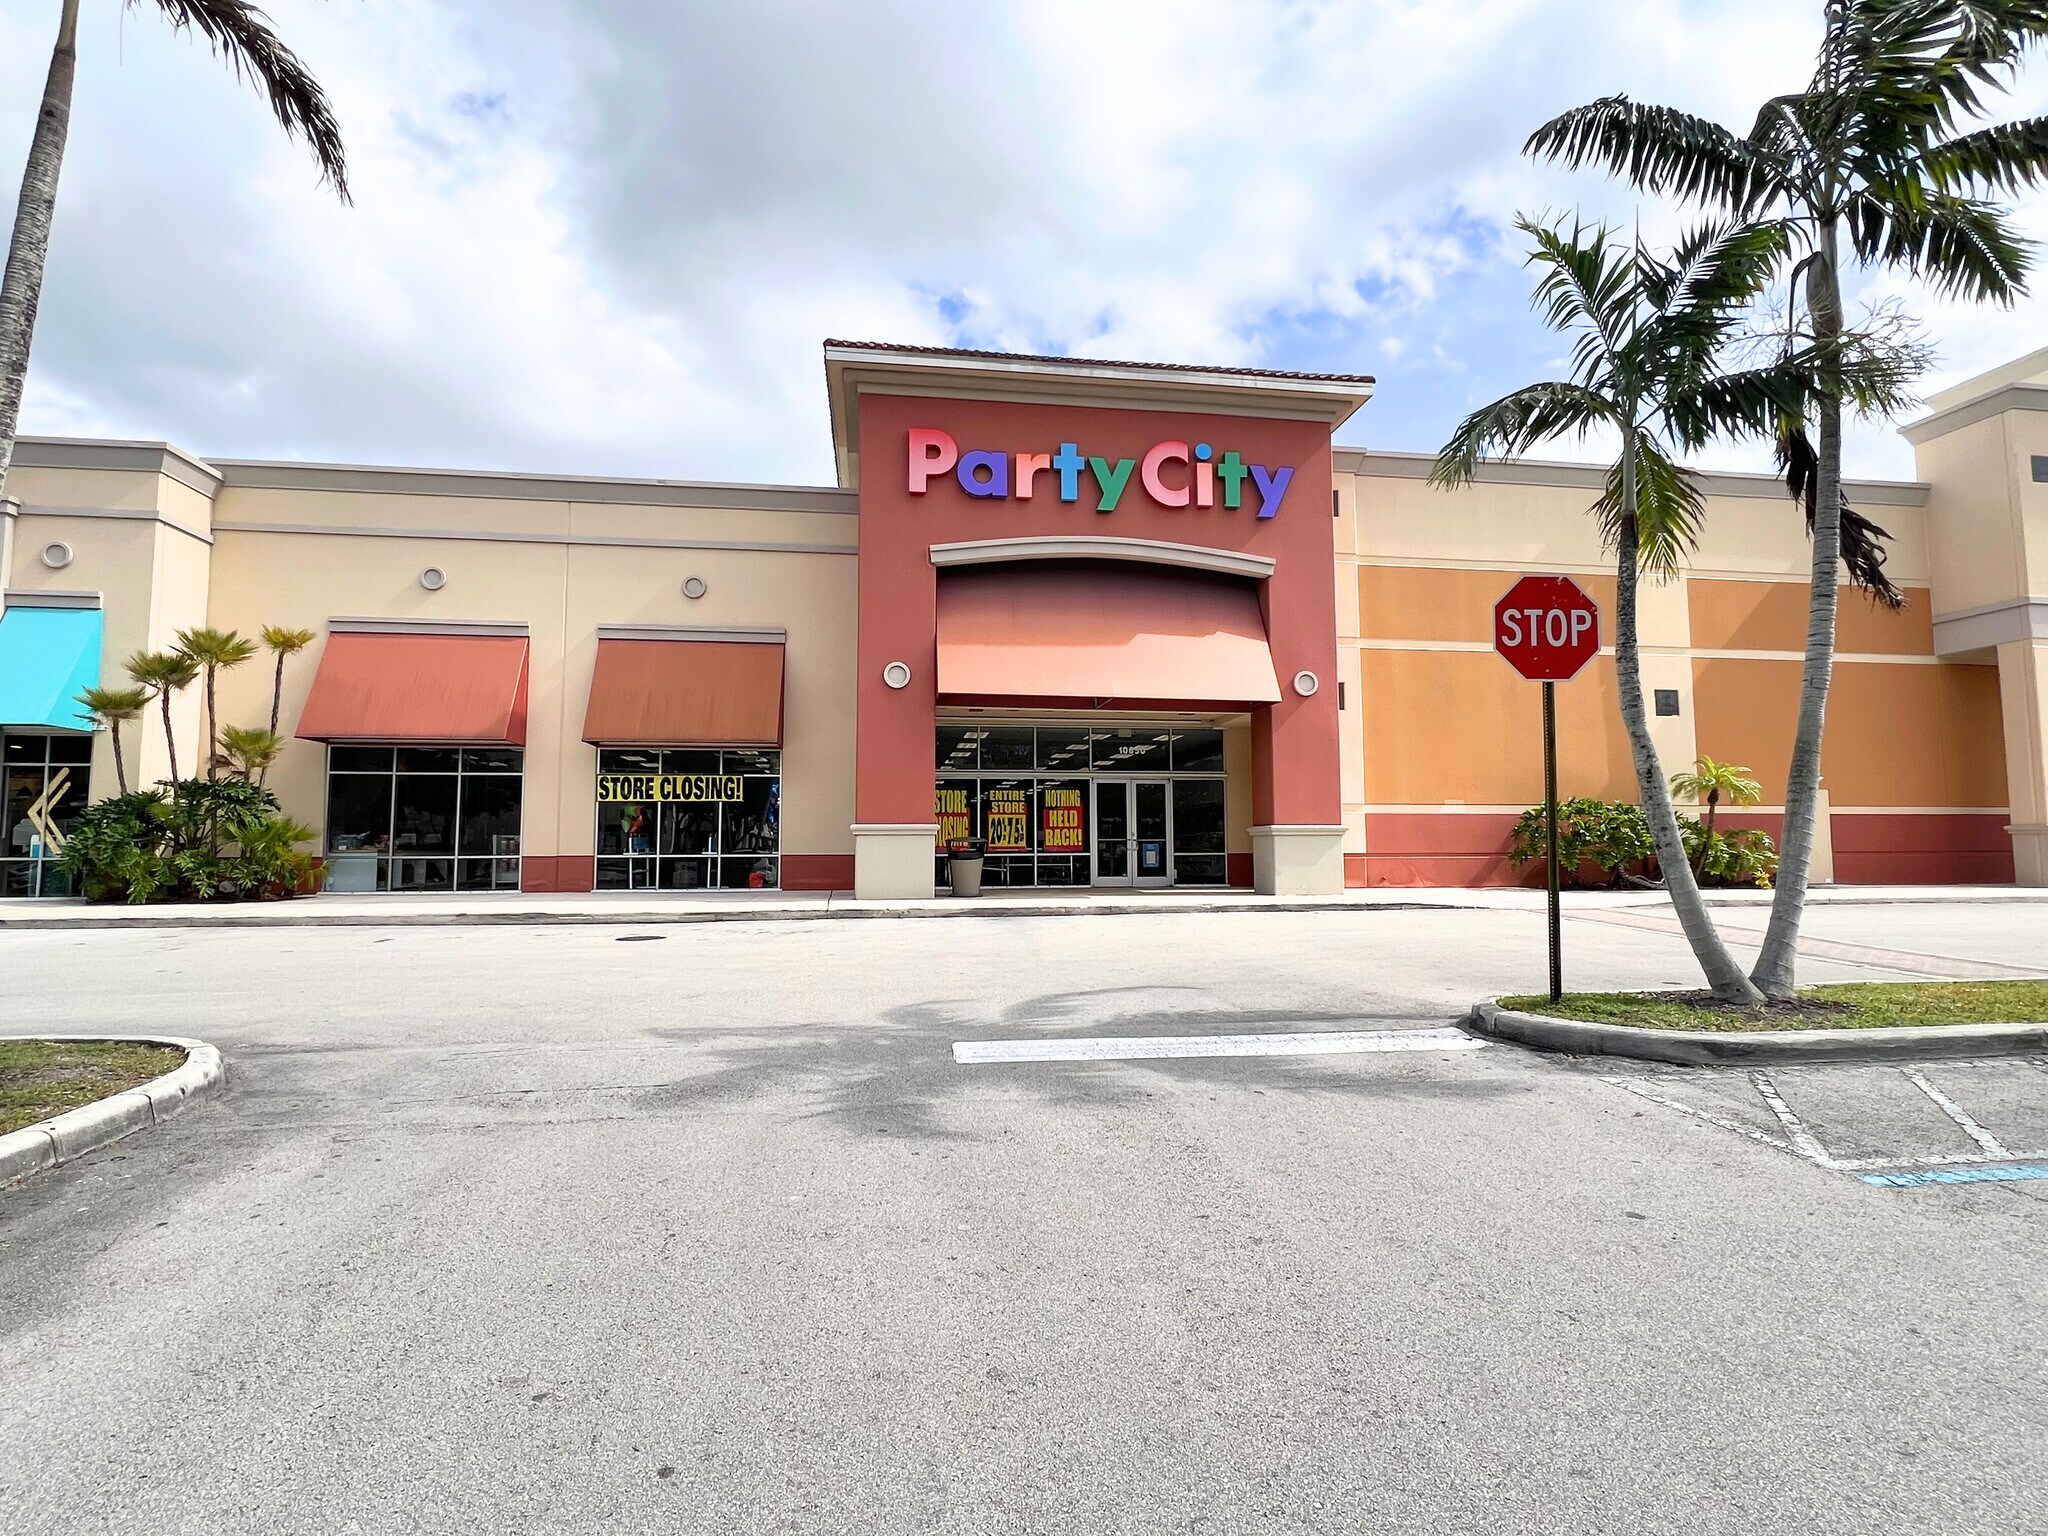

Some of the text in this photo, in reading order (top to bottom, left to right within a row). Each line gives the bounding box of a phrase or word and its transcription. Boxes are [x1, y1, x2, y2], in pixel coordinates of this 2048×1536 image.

[908, 428, 1296, 520] Party City
[1501, 608, 1592, 647] STOP
[598, 776, 742, 800] STORE CLOSING!
[990, 790, 1025, 801] ENTIRE
[935, 789, 967, 813] STORE
[1045, 789, 1081, 807] NOTHING
[992, 802, 1025, 813] STORE
[1049, 810, 1078, 827] HELD
[1045, 829, 1082, 846] BACK!
